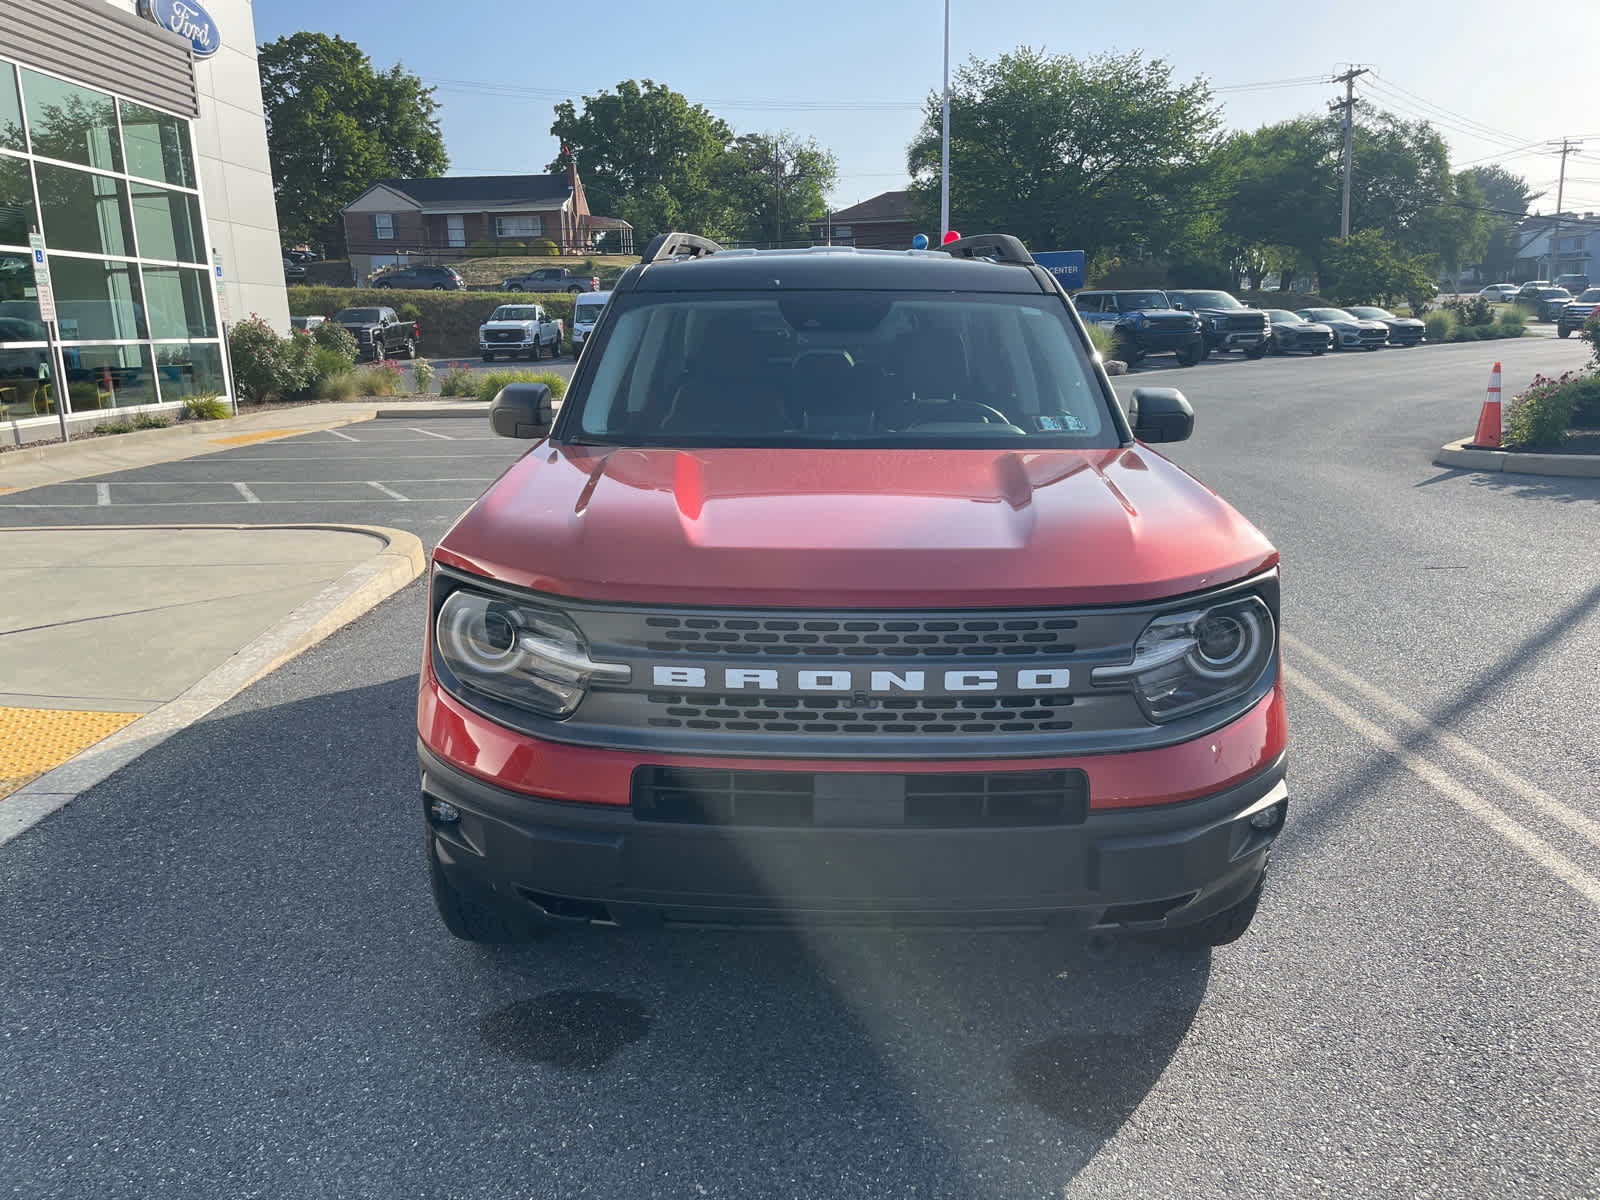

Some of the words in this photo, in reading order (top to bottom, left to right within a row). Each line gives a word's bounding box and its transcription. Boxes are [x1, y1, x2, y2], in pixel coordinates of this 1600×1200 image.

[171, 1, 210, 46] Ford
[1049, 265, 1078, 274] CENTER
[653, 666, 1070, 691] BRONCO
